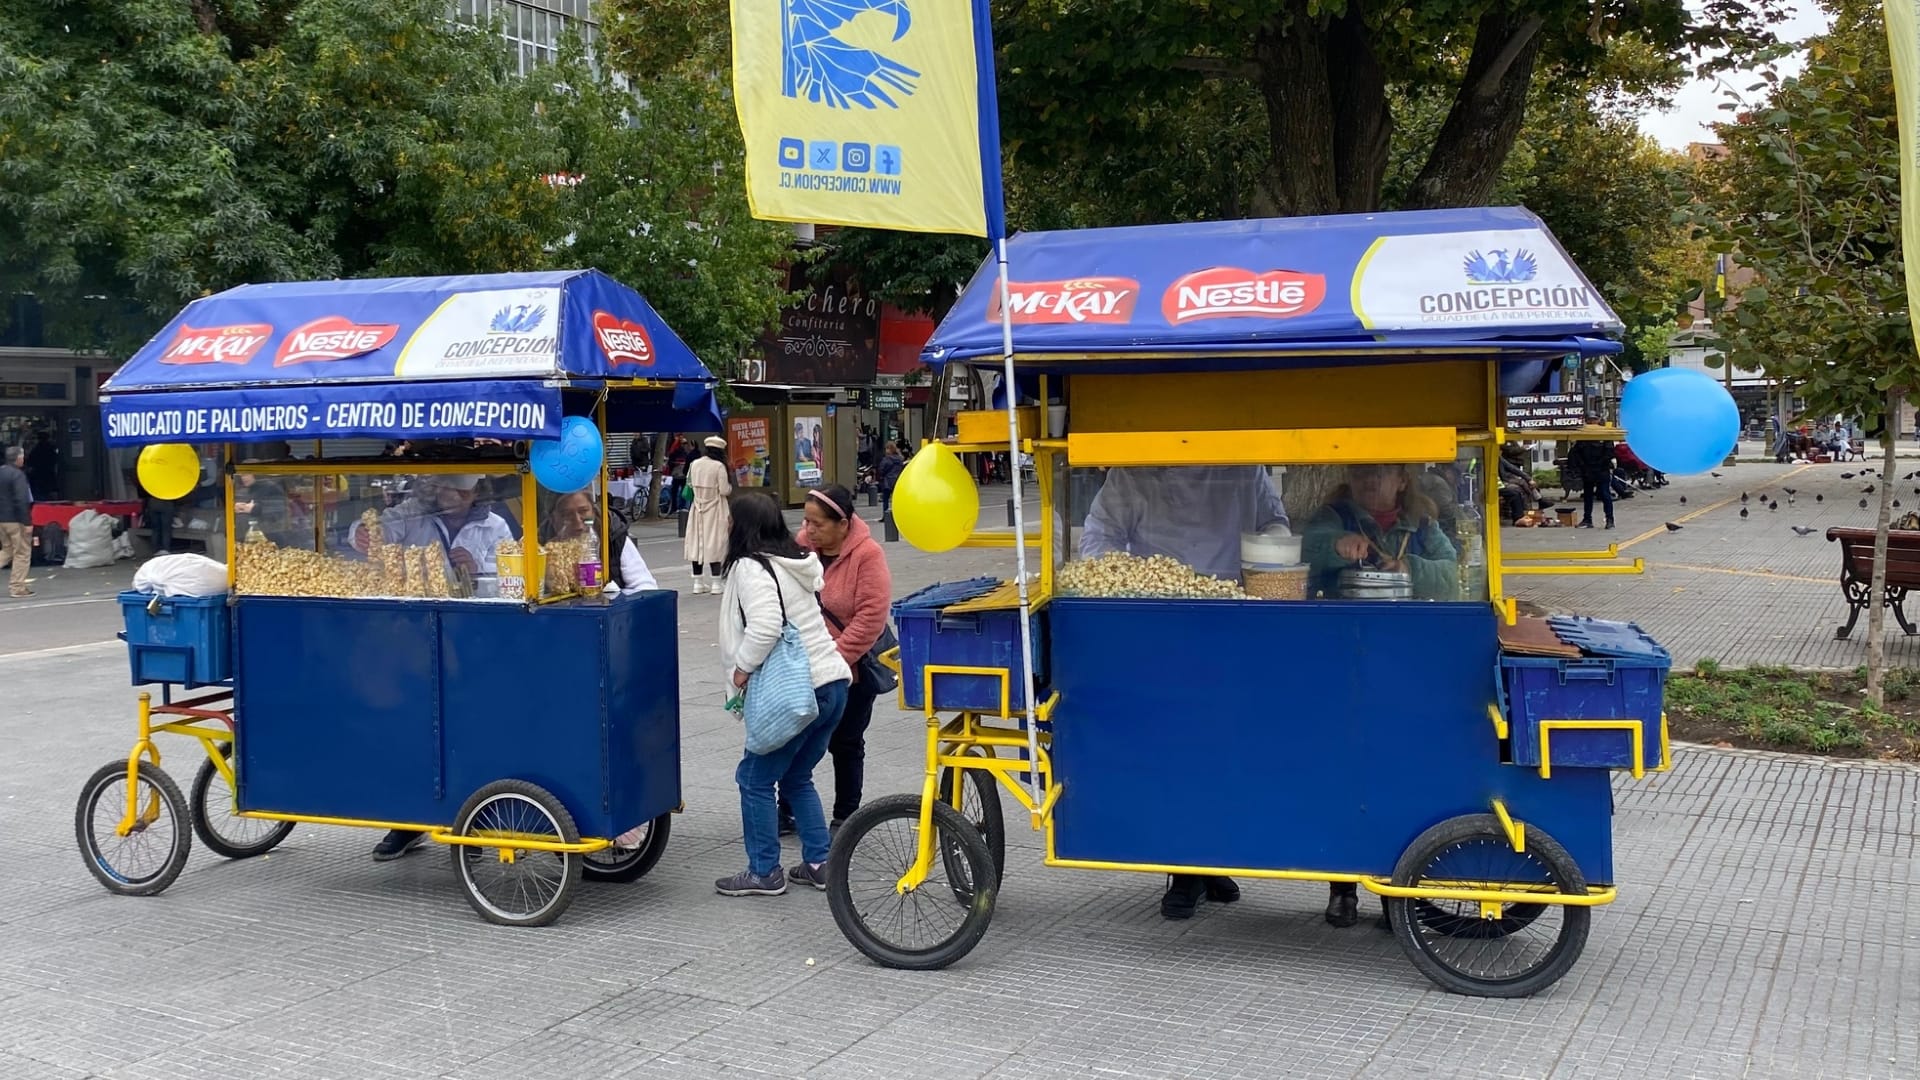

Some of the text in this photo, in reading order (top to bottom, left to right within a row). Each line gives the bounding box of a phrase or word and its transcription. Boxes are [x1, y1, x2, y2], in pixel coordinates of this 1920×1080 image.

[1178, 280, 1305, 307] Nestlé
[1420, 284, 1590, 313] CONCEPCIÓN
[1483, 312, 1499, 320] LA
[1502, 310, 1592, 320] INDEPENDENCIA
[289, 329, 384, 352] Nestlé
[444, 336, 556, 358] CONCEPCIÓN
[599, 327, 648, 353] Nestlé
[108, 409, 182, 437] SINDICATO
[186, 408, 207, 434] DE
[210, 405, 308, 432] PALOMEROS
[326, 402, 398, 428] CENTRO
[402, 402, 425, 428] DE
[429, 401, 546, 430] CONCEPCION
